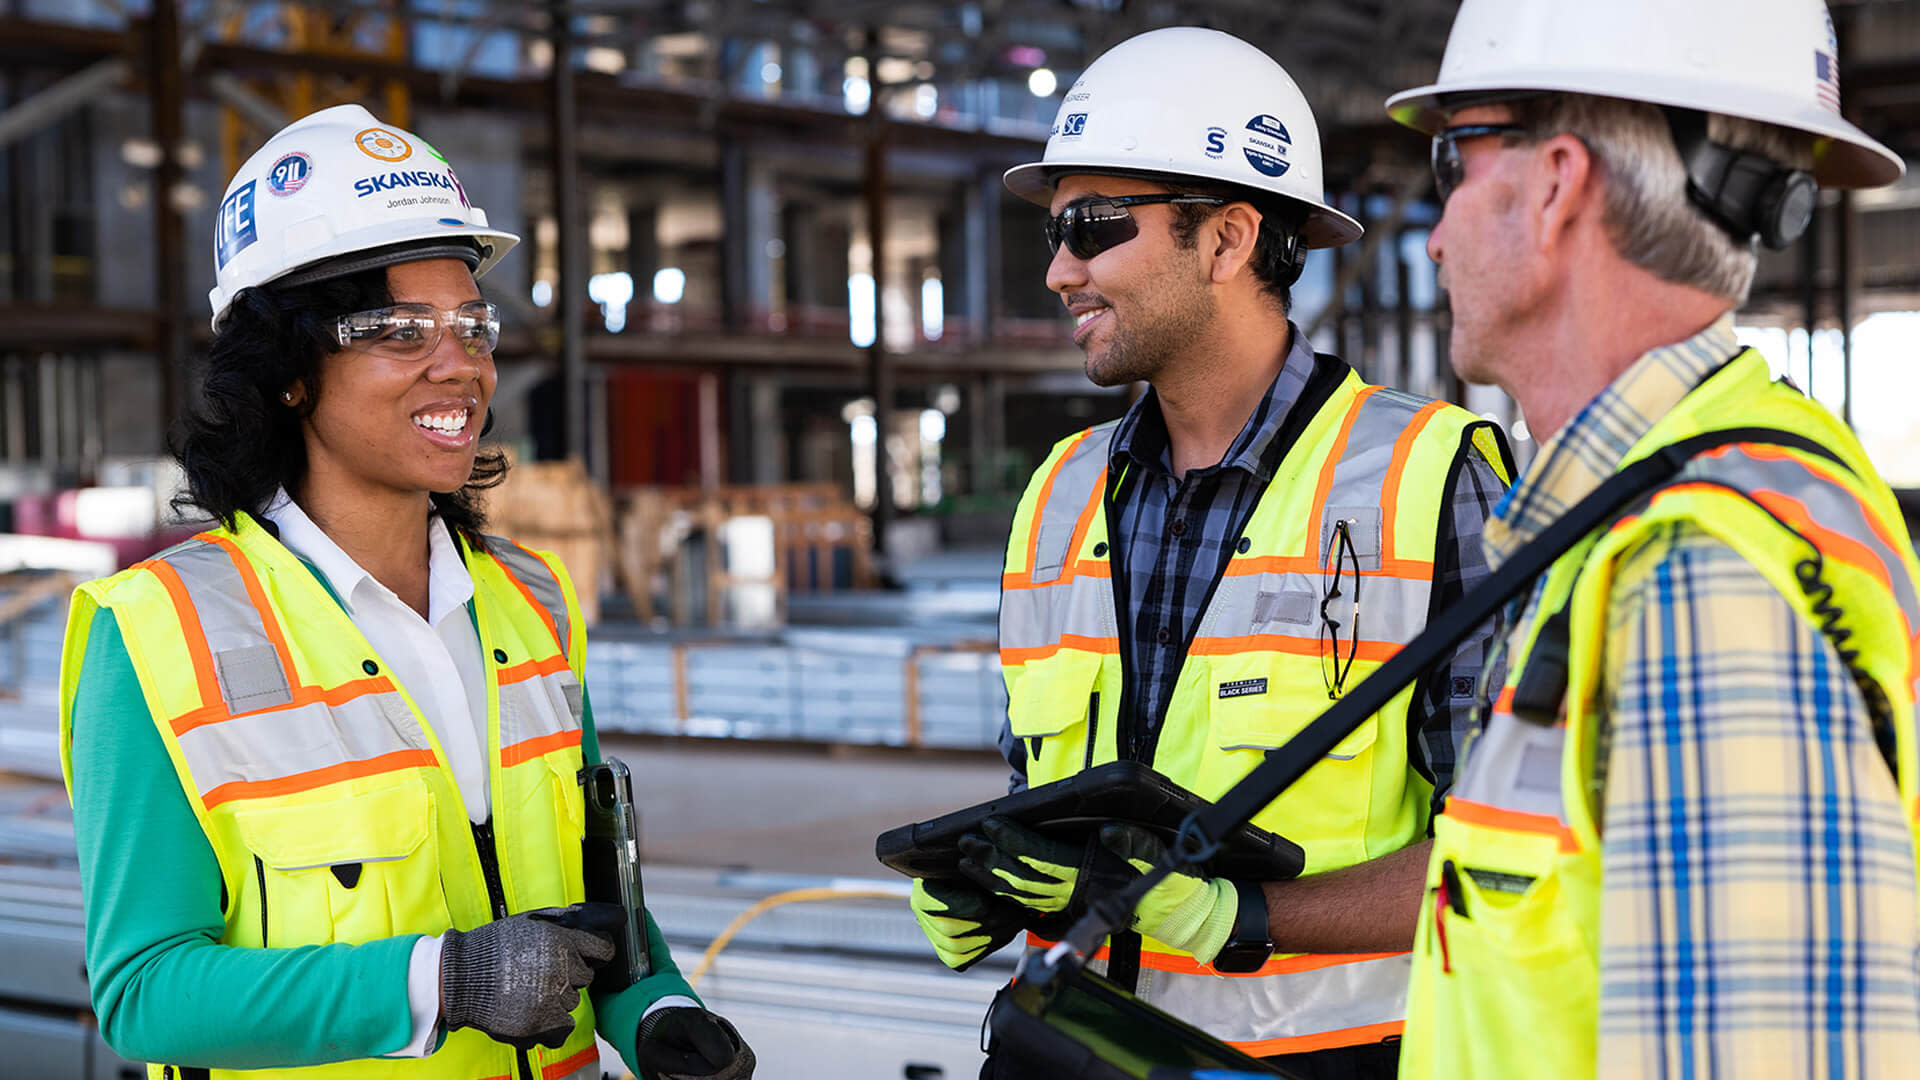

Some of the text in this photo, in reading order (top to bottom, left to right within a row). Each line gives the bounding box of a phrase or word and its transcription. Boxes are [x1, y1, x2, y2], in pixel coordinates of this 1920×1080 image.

[1206, 132, 1225, 153] S
[276, 162, 300, 183] 911
[354, 171, 456, 198] SKANSKA
[387, 195, 451, 209] Jordan Johnson
[1220, 684, 1263, 697] BLACK SERIES
